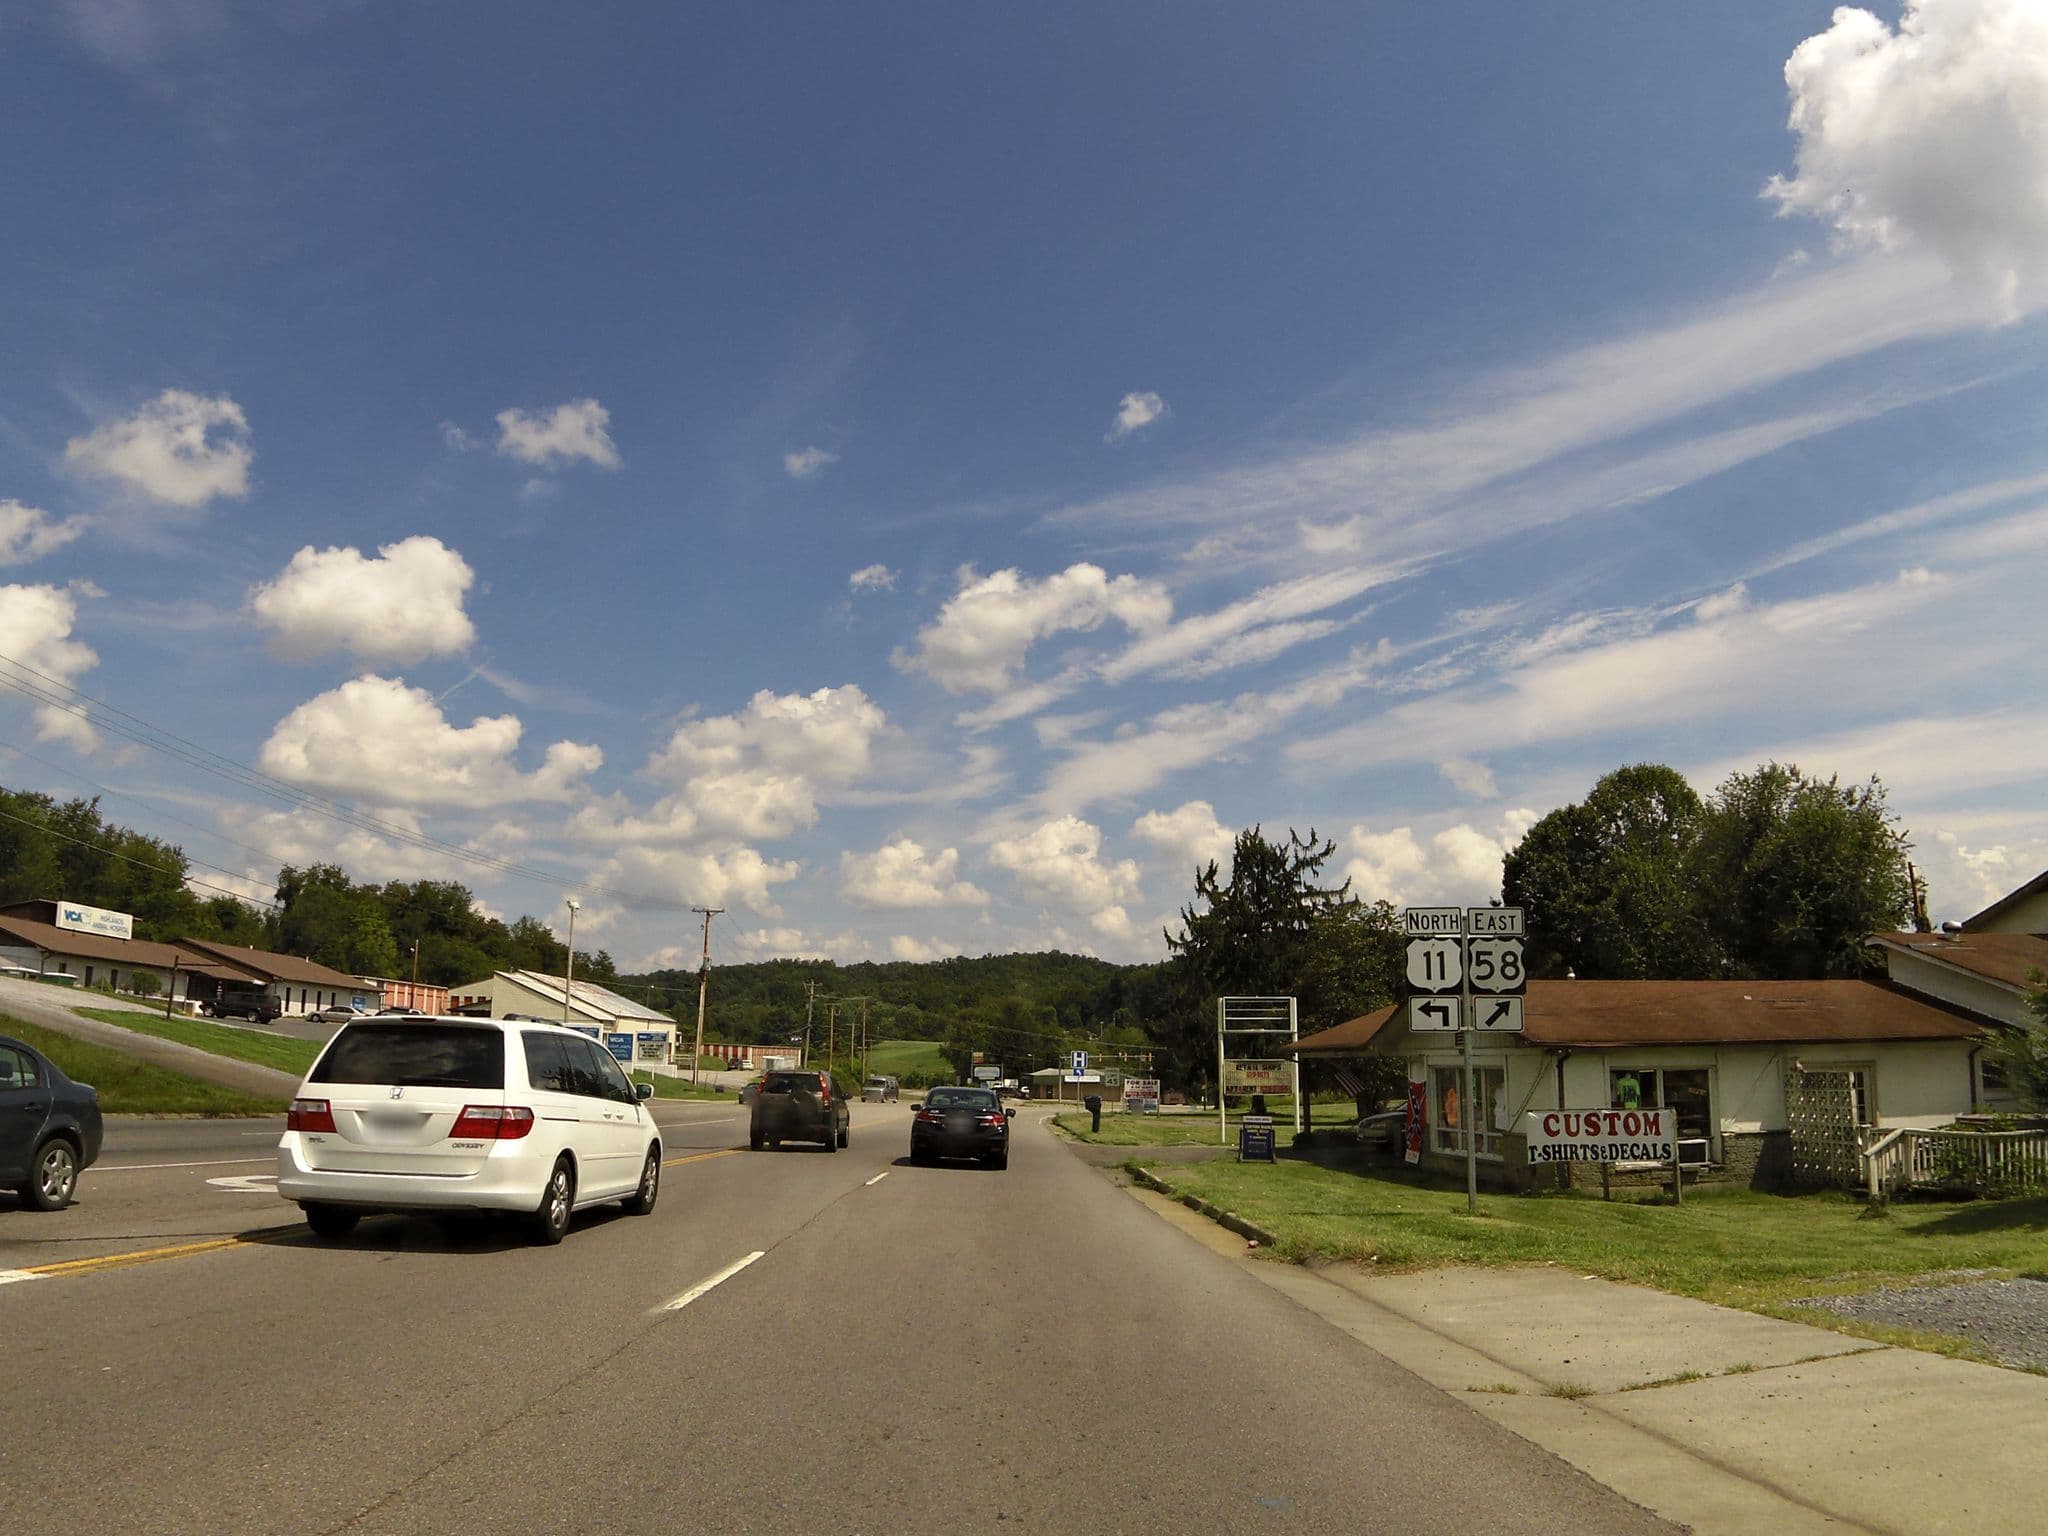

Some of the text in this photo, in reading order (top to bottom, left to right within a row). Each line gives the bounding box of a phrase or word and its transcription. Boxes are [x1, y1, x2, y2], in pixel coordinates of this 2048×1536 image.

[1408, 912, 1460, 931] NORTH
[1474, 912, 1517, 931] EAST
[1423, 950, 1446, 981] 11
[1475, 950, 1520, 981] 58
[1073, 1052, 1085, 1068] H
[1543, 1112, 1661, 1138] CUSTOM
